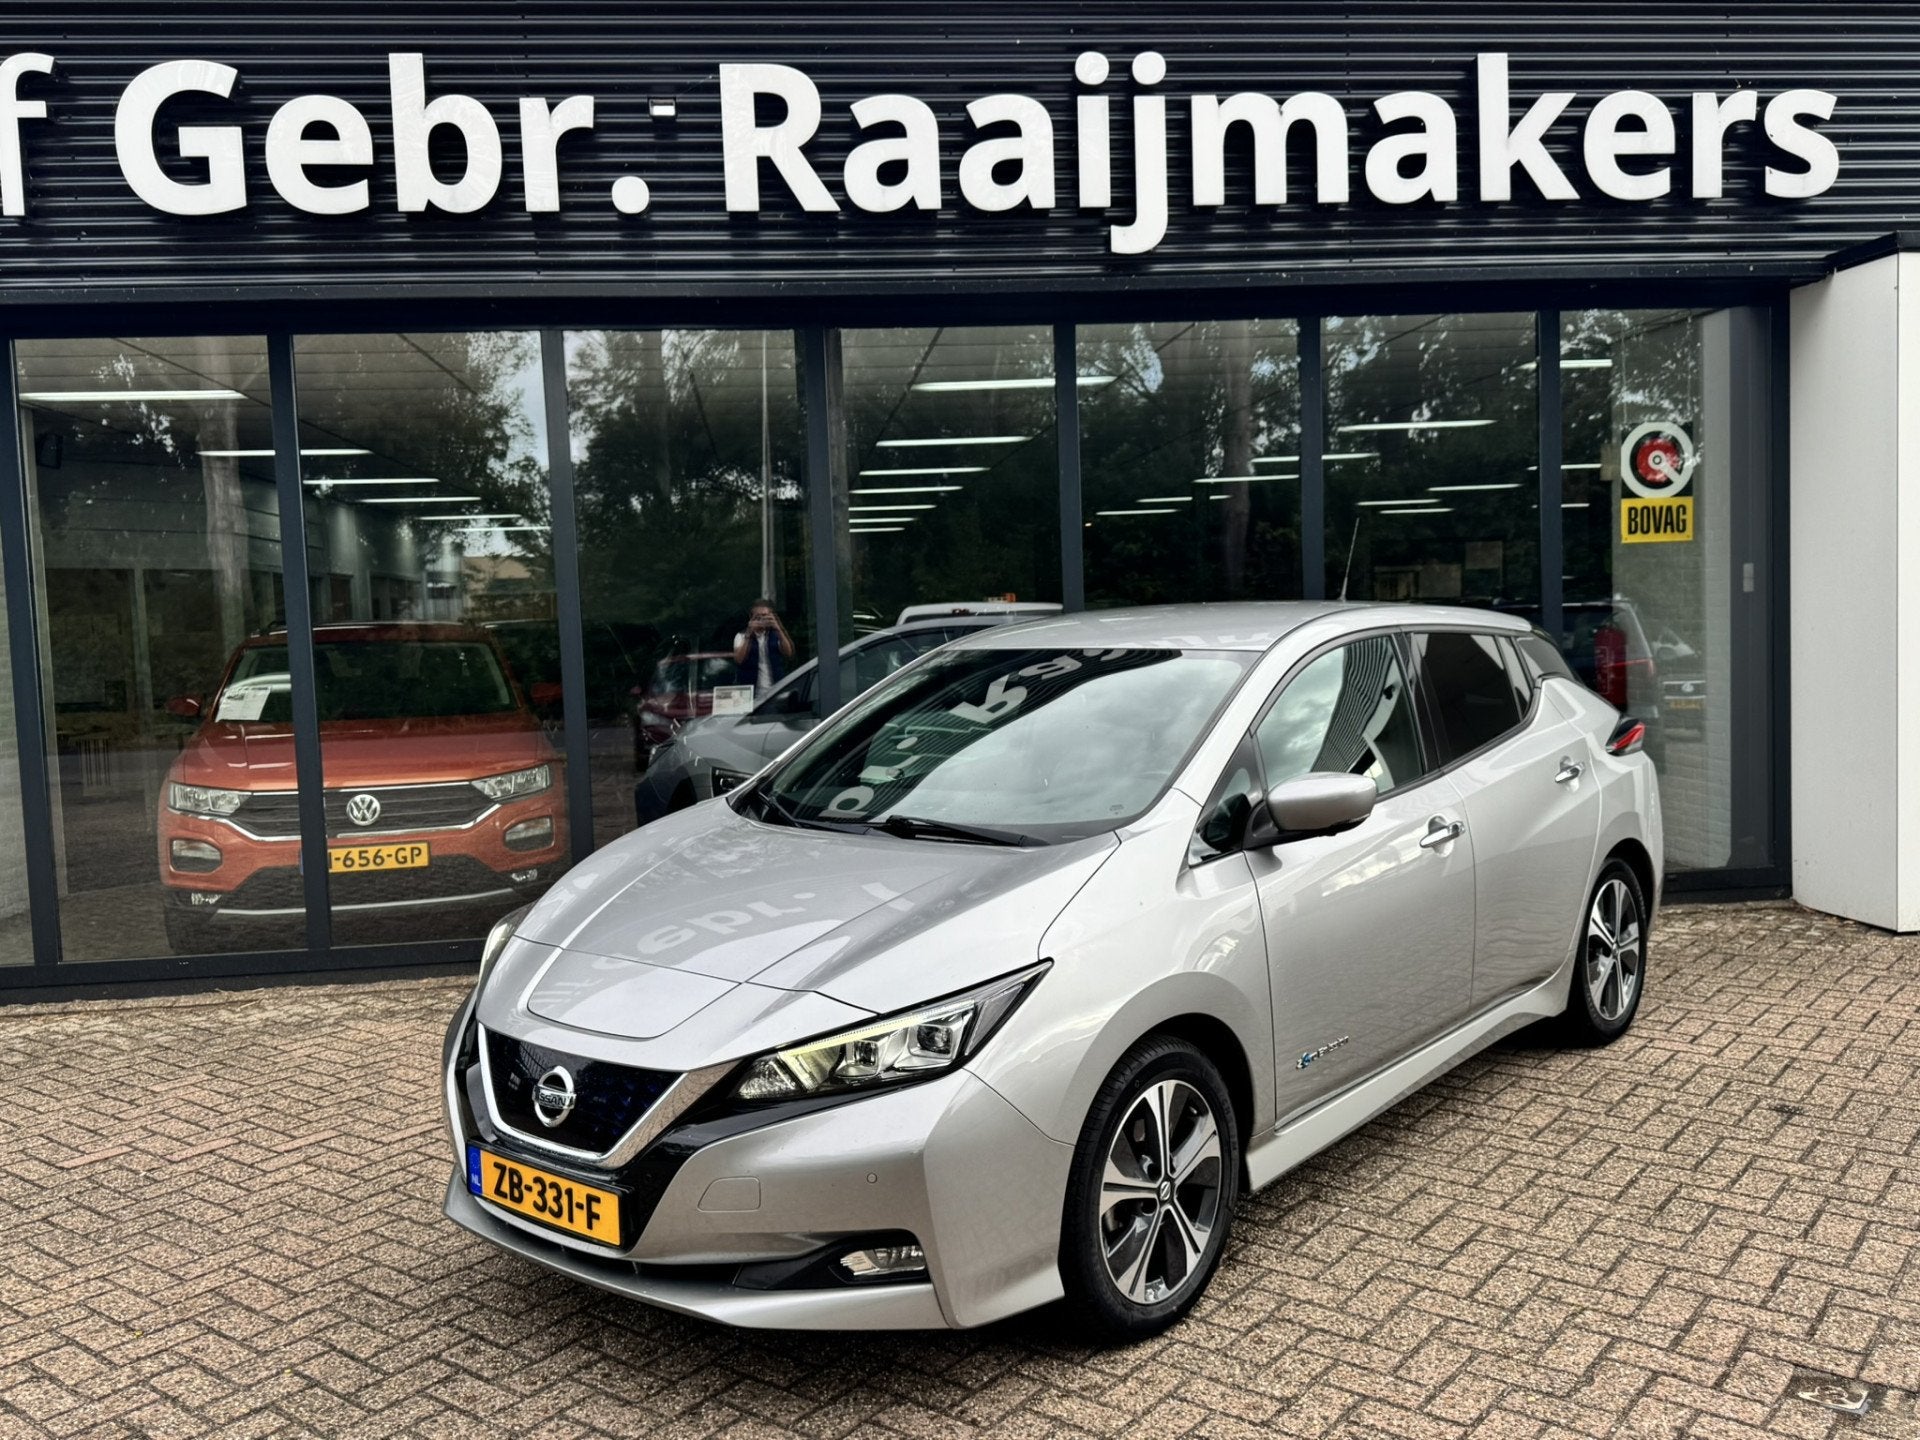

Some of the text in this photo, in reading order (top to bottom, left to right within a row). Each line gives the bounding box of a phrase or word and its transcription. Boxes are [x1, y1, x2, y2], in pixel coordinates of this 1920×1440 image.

[115, 53, 650, 215] Gebr.
[719, 52, 1840, 254] Raaijmakers
[1627, 504, 1687, 534] BOVAG
[533, 1087, 568, 1106] SSAN
[471, 1173, 481, 1187] NL
[493, 1161, 602, 1230] ZB-331-F
